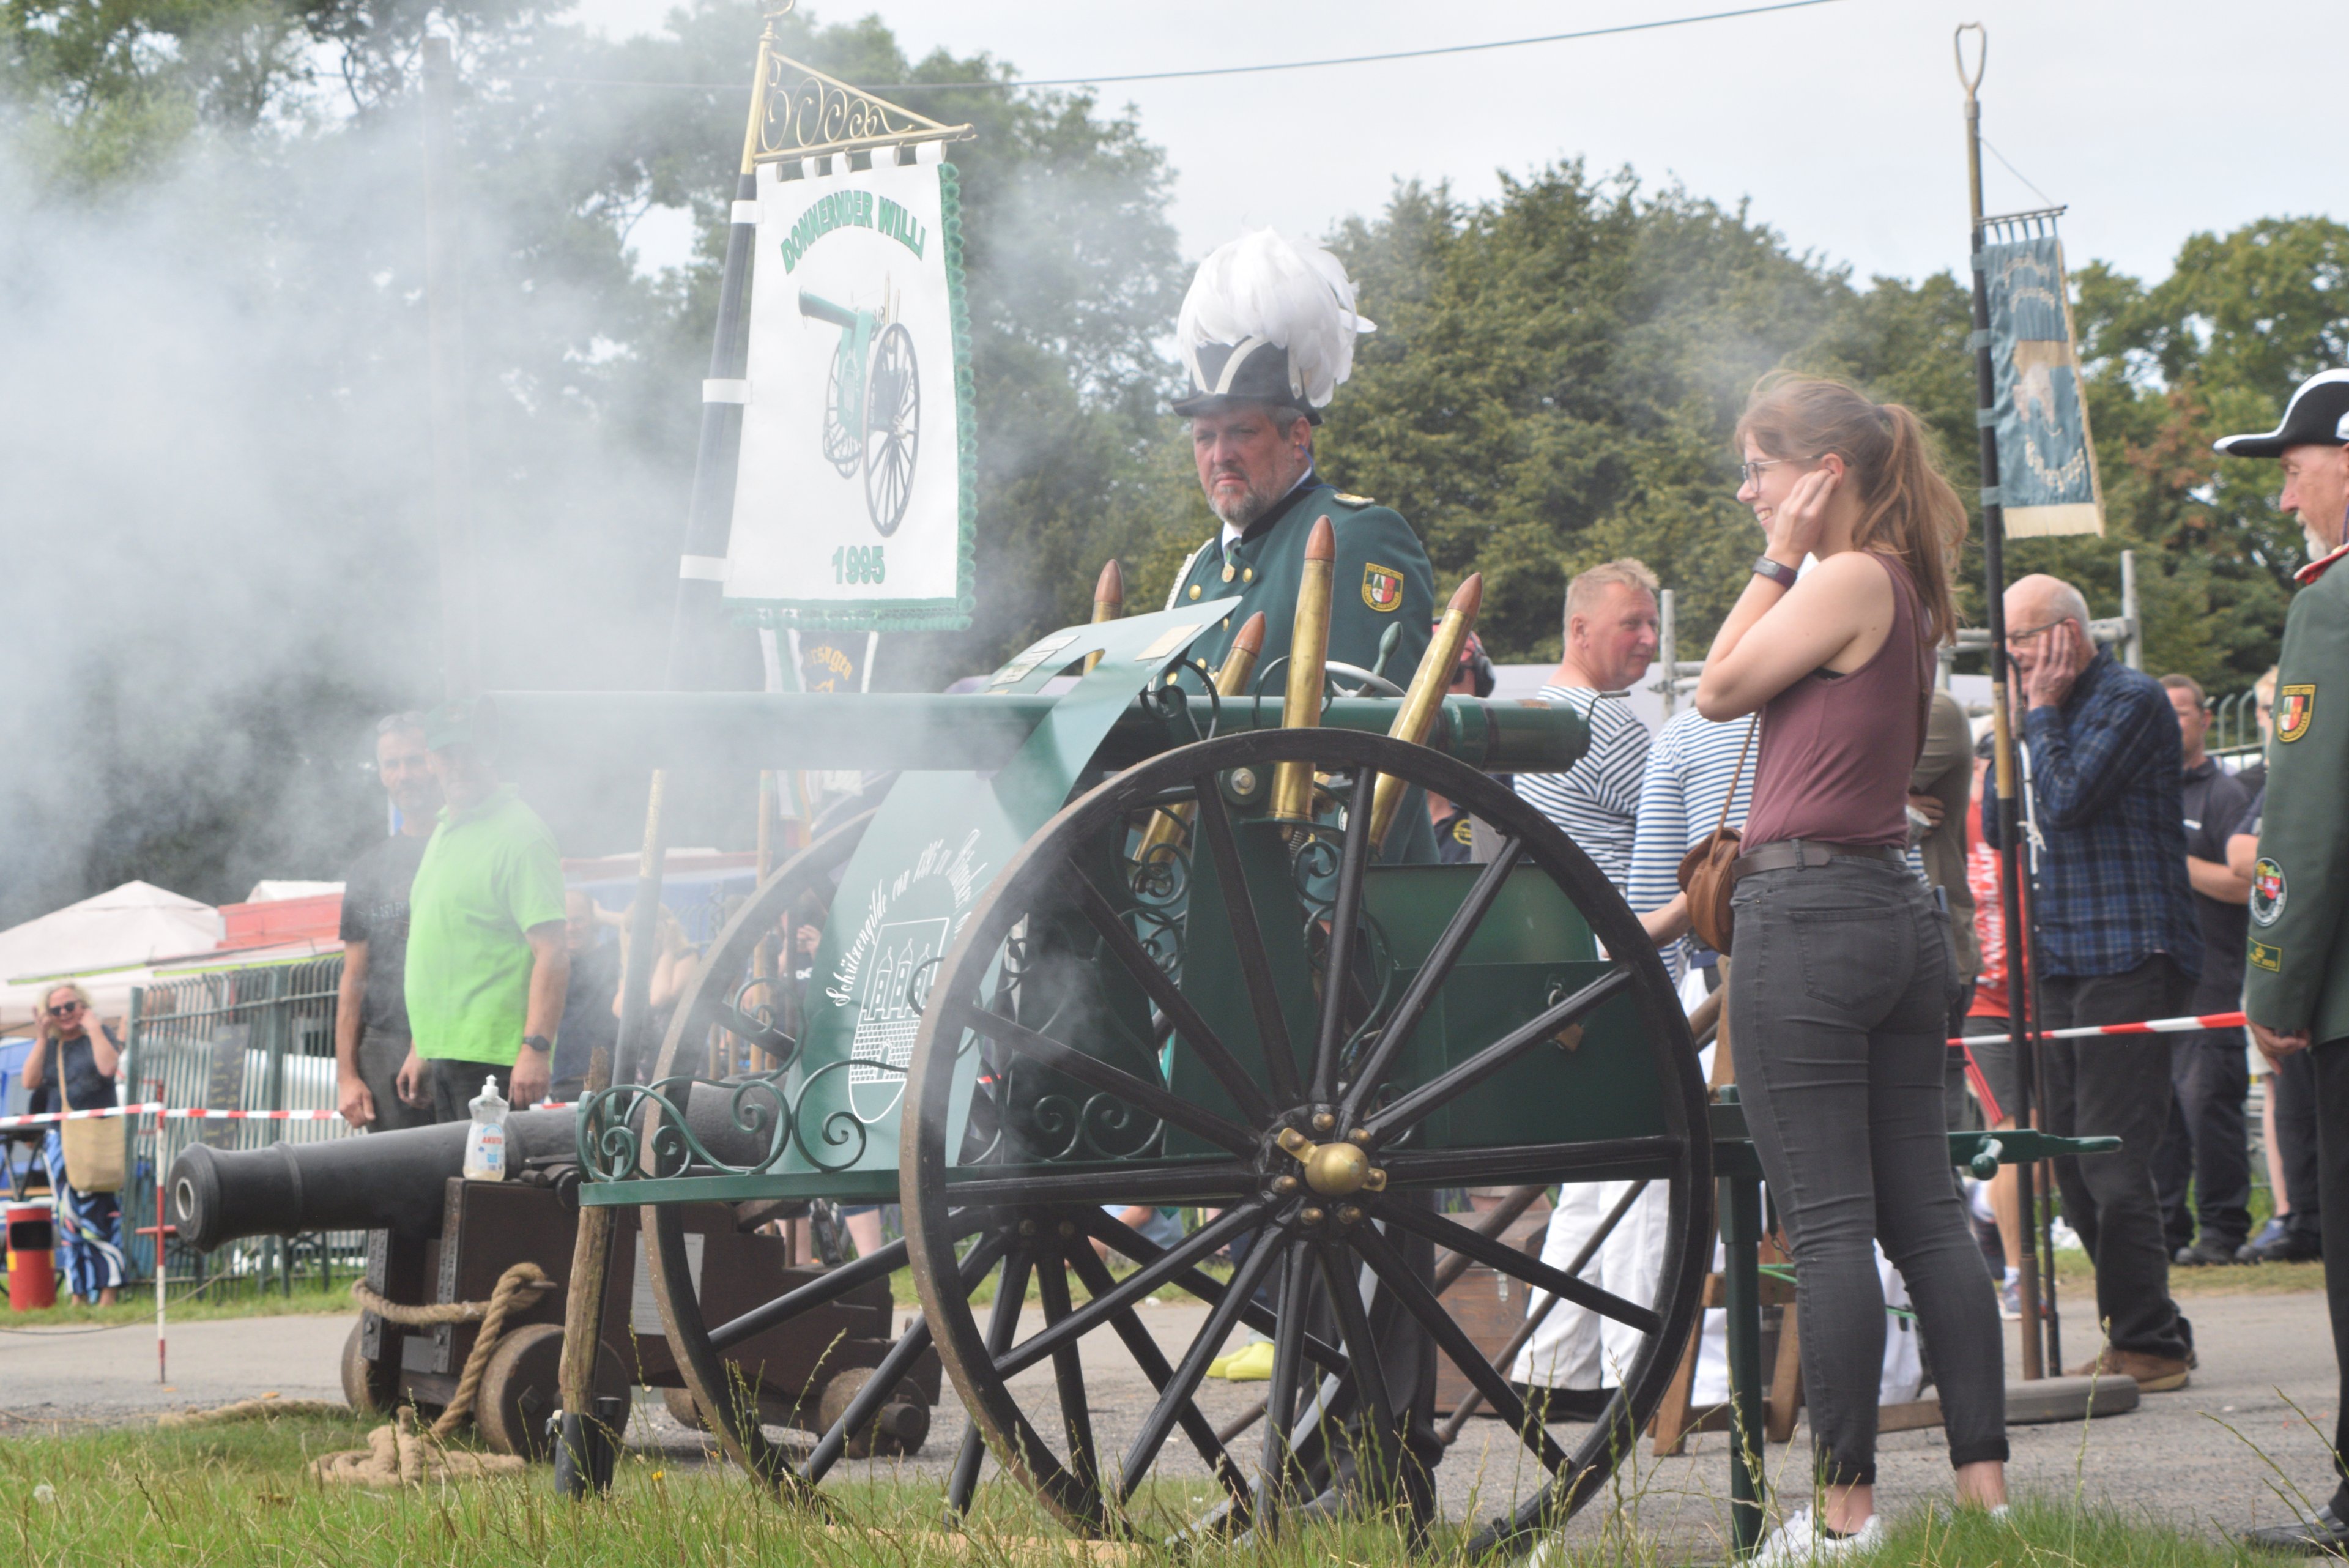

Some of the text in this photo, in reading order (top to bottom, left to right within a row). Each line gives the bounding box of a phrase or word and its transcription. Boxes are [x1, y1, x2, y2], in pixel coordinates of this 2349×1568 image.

[781, 190, 926, 275] DONNERNDER WILLI
[831, 545, 885, 585] 1995
[826, 878, 886, 1007] Schützengilde
